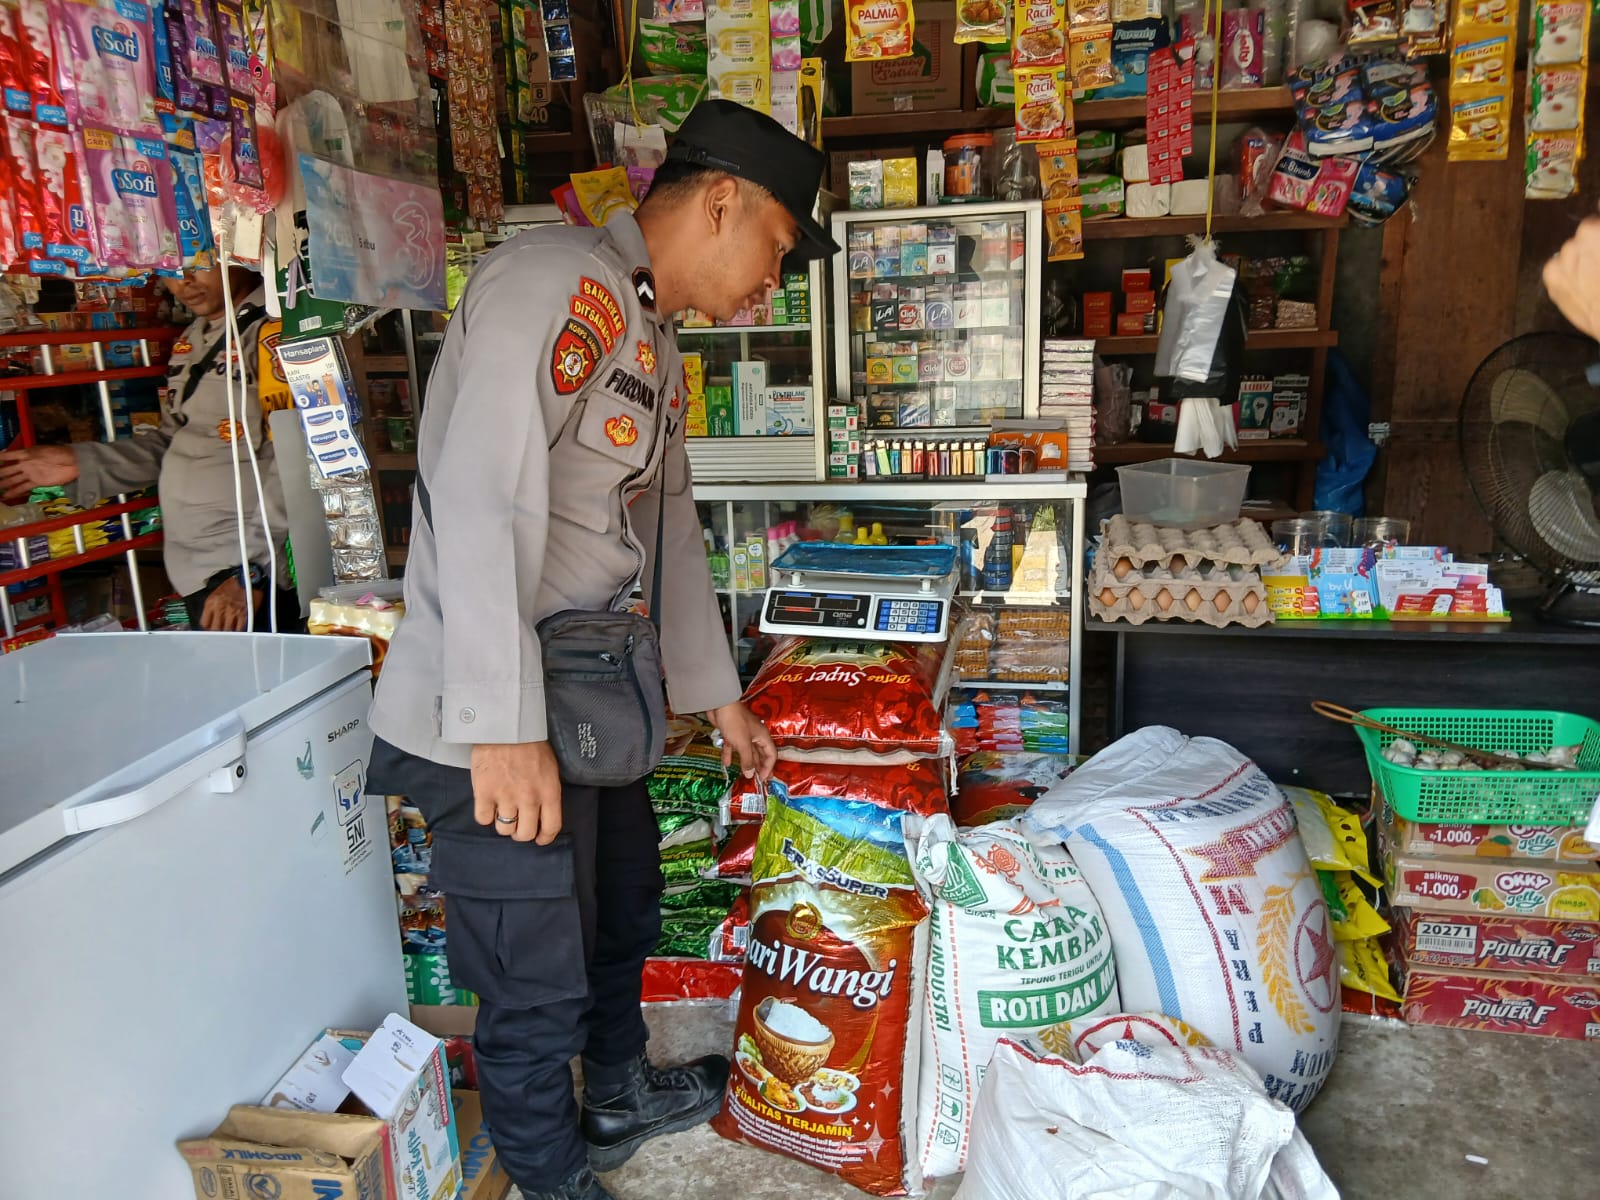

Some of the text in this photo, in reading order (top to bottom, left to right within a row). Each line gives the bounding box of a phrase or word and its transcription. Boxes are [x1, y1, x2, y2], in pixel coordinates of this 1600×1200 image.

[858, 8, 899, 20] PALMIA
[1026, 7, 1056, 21] Racik
[1460, 46, 1502, 60] ENERGEN
[1026, 79, 1056, 96] Racik
[1456, 105, 1498, 119] ENERGEN
[283, 343, 327, 360] Hansaplast
[831, 407, 844, 415] ABC
[804, 666, 867, 687] Super
[867, 673, 912, 685] Beras
[327, 719, 360, 743] SHARP
[346, 818, 365, 850] SNI
[823, 867, 888, 900] SUPER
[1423, 872, 1460, 882] asiknya
[1498, 873, 1550, 893] OKKY
[943, 884, 972, 899] HALAL
[1506, 890, 1545, 907] Jelly
[1422, 924, 1471, 938] 20271
[996, 915, 1104, 970] KEMBAR
[1479, 940, 1553, 959] POWER
[1551, 944, 1576, 962] F
[1021, 976, 1056, 986] TEPUNG
[1058, 965, 1086, 981] TERIGU
[930, 944, 951, 1032] INDUSTRI
[990, 994, 1048, 1022] ROTI
[1055, 978, 1098, 1016] DAN
[1460, 999, 1557, 1024] POWER F
[735, 1085, 783, 1122] KUALITAS
[784, 1113, 854, 1137] TERJAMIN
[221, 1148, 304, 1161] INDOMILK
